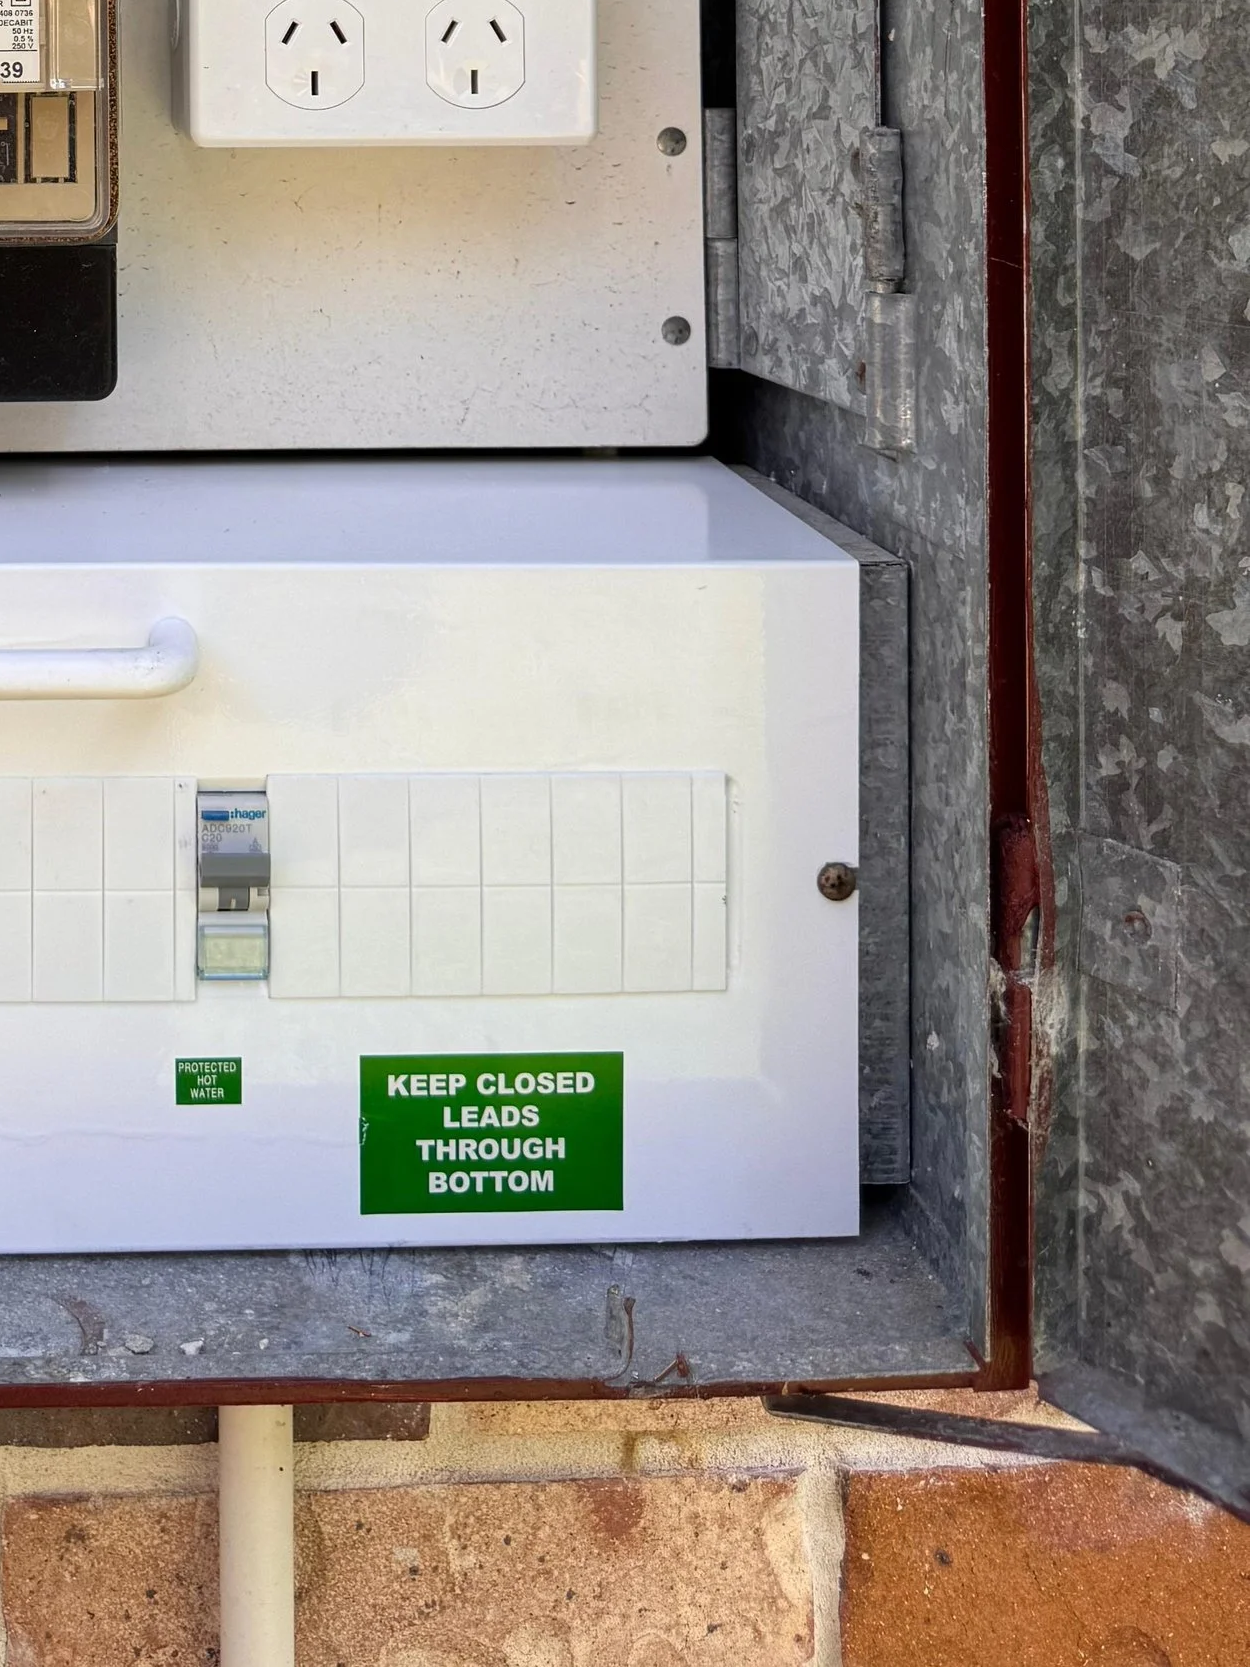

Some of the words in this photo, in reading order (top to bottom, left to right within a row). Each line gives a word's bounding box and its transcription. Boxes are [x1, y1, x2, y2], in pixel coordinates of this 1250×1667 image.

[179, 1062, 236, 1072] PROTECTED
[198, 1075, 217, 1085] HOT
[388, 1074, 466, 1096] KEEP
[477, 1072, 594, 1095] CLOSED
[190, 1088, 224, 1098] WATER
[444, 1105, 539, 1127] LEADS
[416, 1138, 565, 1160] THROUGH
[429, 1170, 553, 1193] BOTTOM
